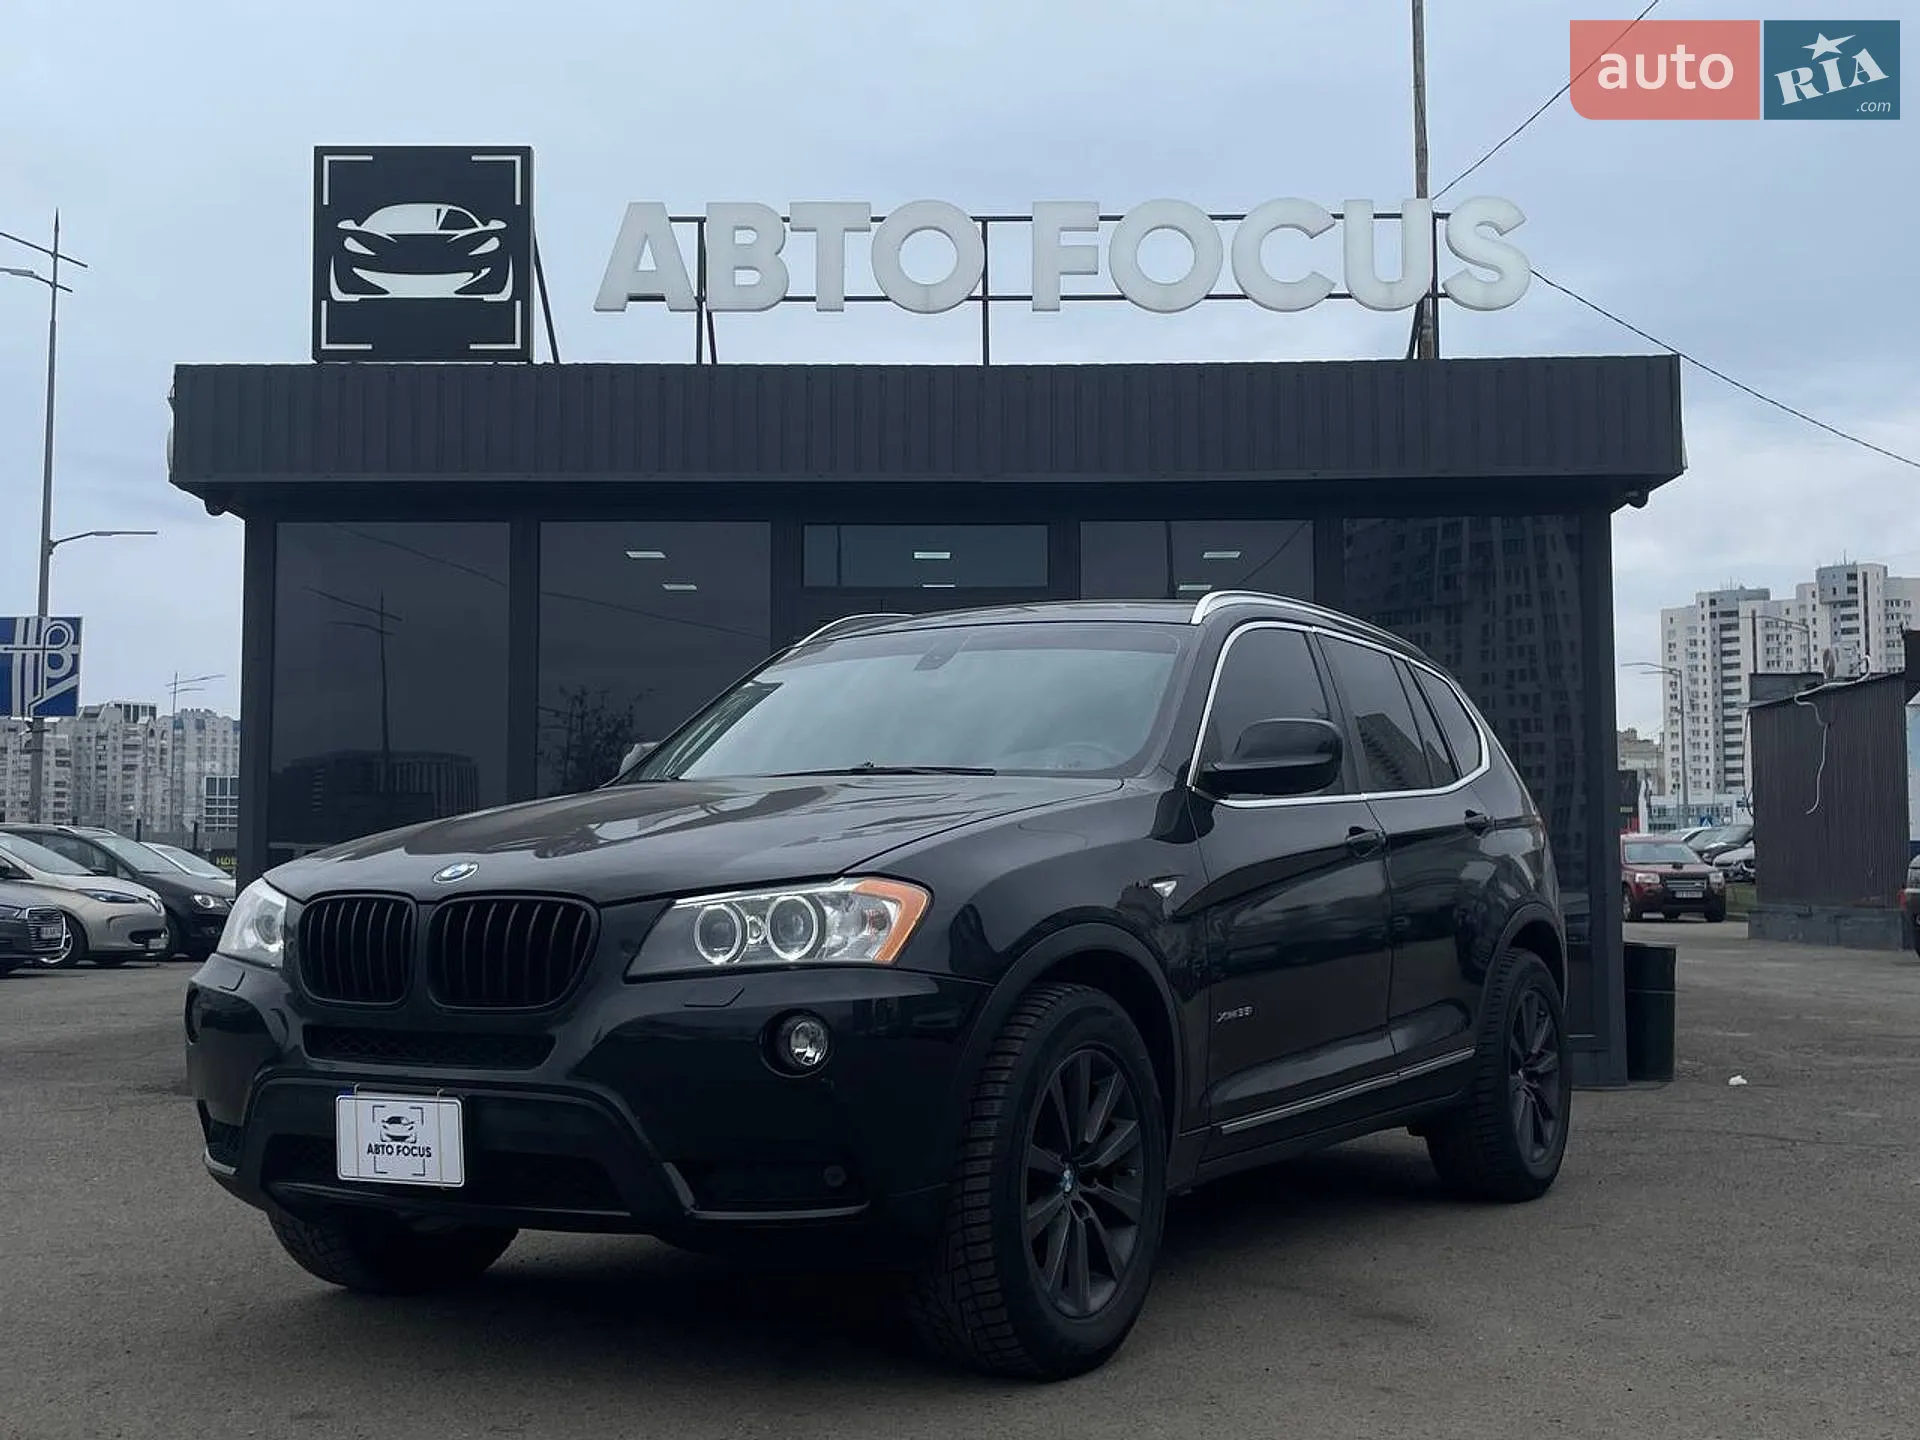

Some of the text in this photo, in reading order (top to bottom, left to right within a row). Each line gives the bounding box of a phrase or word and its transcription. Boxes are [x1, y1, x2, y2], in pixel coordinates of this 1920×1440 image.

[594, 197, 1531, 314] АВТО FOCUS
[367, 1142, 432, 1158] АВТО FOCUS
